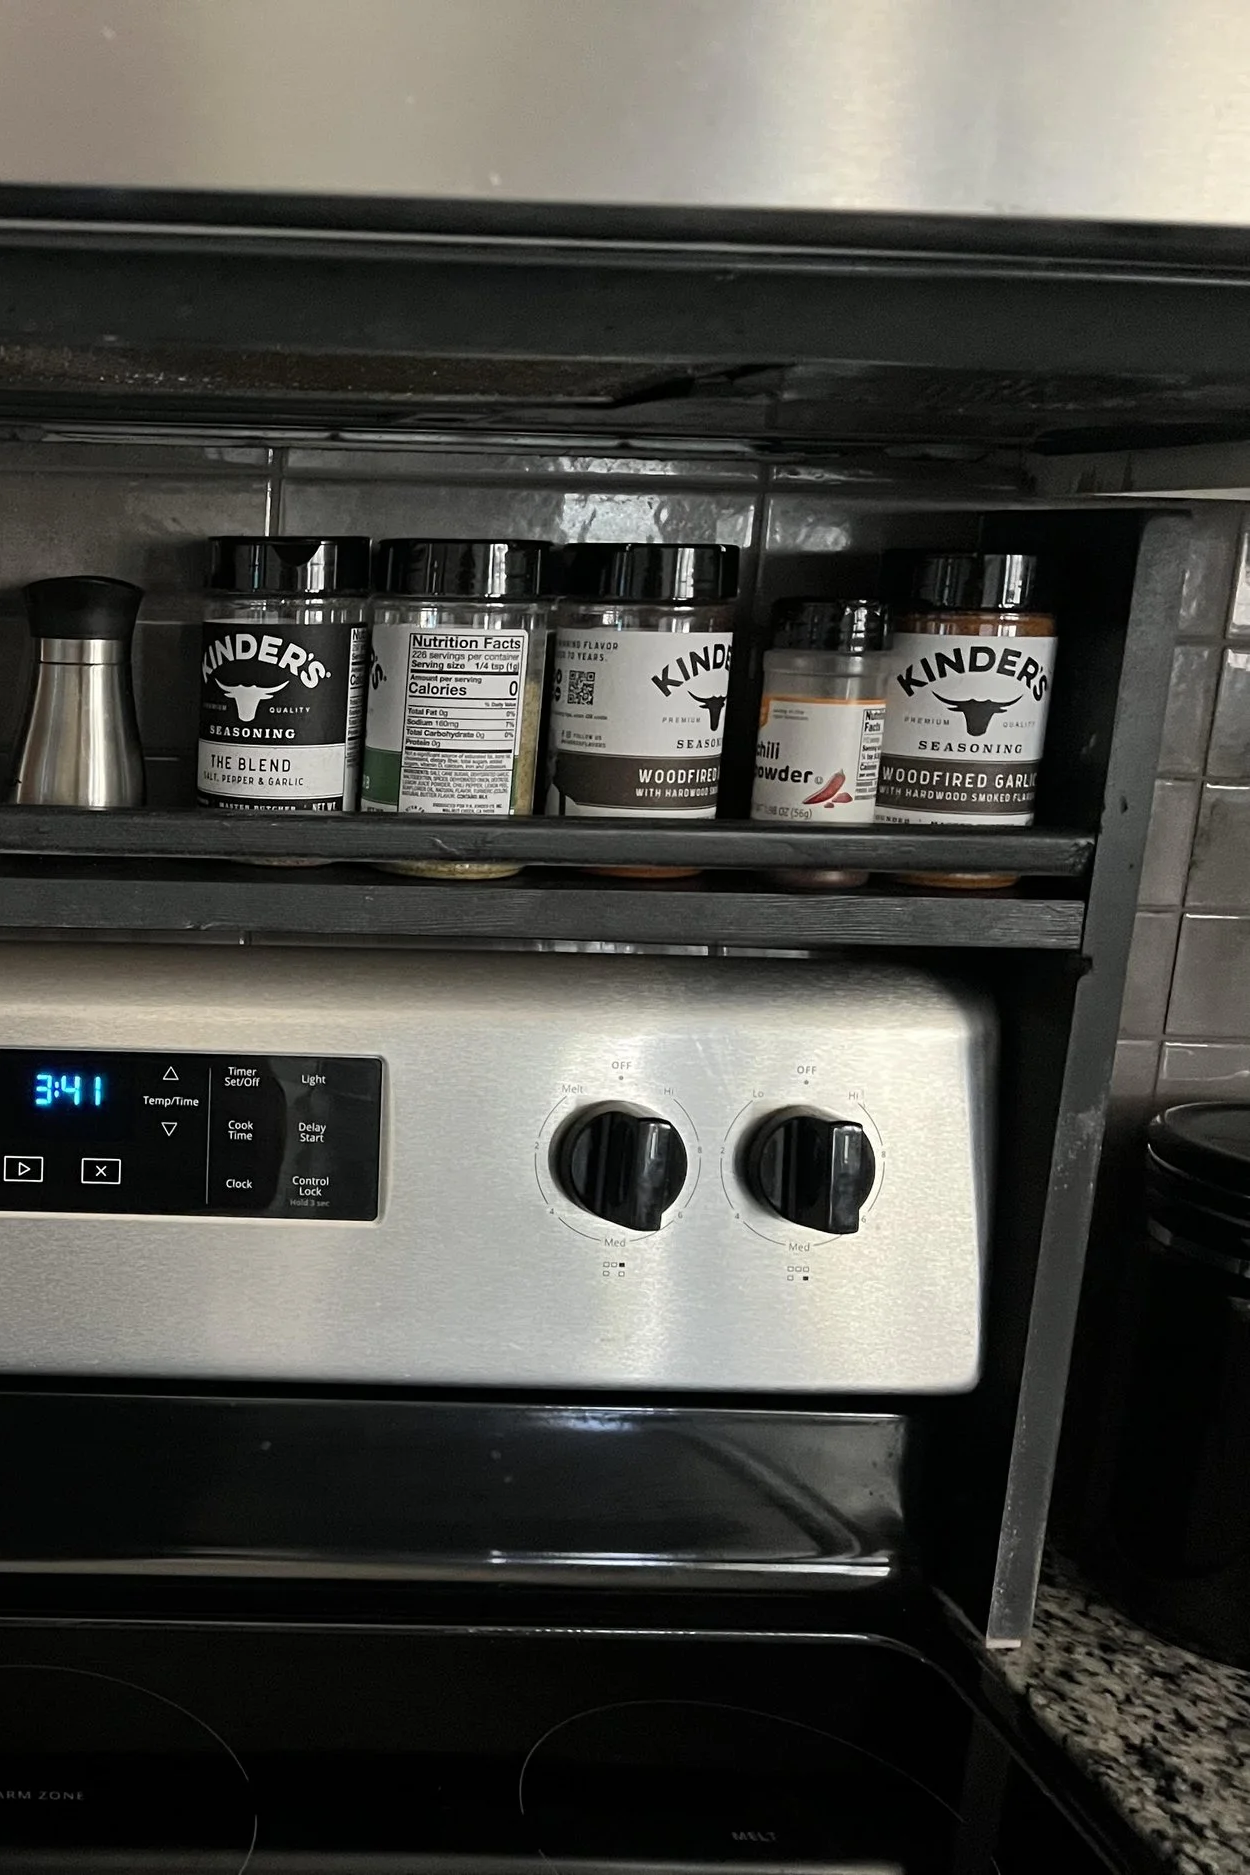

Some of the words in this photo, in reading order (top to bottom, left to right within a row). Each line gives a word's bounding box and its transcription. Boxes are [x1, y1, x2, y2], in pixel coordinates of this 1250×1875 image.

[412, 635, 478, 649] Nutrition
[484, 637, 521, 649] Facts
[583, 641, 619, 650] FLAVOR
[202, 633, 327, 689] KINDER'S
[412, 651, 427, 659] 226
[430, 652, 465, 661] servings
[467, 654, 482, 662] per
[484, 653, 519, 661] container
[411, 660, 444, 670] Serving
[447, 661, 465, 669] size
[475, 662, 489, 670] 1/4
[491, 663, 504, 671] tsp
[410, 674, 438, 682] Amount
[897, 646, 1048, 702] KINDER'S
[409, 682, 467, 696] Calories
[509, 681, 518, 697] 0
[269, 706, 310, 714] QUALITY
[408, 707, 424, 715] Total
[425, 708, 437, 716] Fat
[439, 709, 448, 717] 0g
[407, 718, 433, 727] Sodium
[904, 716, 950, 726] PREMIUM
[209, 725, 296, 739] SEASONING
[424, 729, 474, 739] Carbohydrate
[918, 740, 1023, 754] SEASONING
[211, 754, 232, 770] THE
[238, 757, 291, 772] BLEND
[222, 775, 254, 785] PEPPER
[258, 777, 264, 785] &
[268, 777, 304, 786] GARLIC
[638, 767, 717, 784] WOODFIRED
[882, 766, 988, 788] WOODFIRED
[635, 788, 661, 797] WITH
[665, 787, 709, 797] HARDWOOD
[879, 785, 901, 795] WITH
[905, 788, 967, 802] HARDWOOD
[972, 793, 1010, 802] SMOKED
[790, 808, 812, 819] (56g)
[611, 1060, 632, 1070] OFF
[797, 1065, 817, 1075] OFF
[228, 1066, 257, 1076] Timer
[224, 1077, 260, 1087] Set/Off
[301, 1074, 326, 1086] Light
[36, 1074, 101, 1106] 3:41
[561, 1084, 584, 1094] Melt
[663, 1086, 674, 1096] Hi
[752, 1089, 764, 1098] Lo
[848, 1090, 859, 1100] Hi
[143, 1095, 200, 1108] Temp/Time
[228, 1120, 254, 1130] Cook
[299, 1122, 326, 1134] Delay
[228, 1130, 253, 1141] Time
[300, 1133, 325, 1143] Start
[226, 1179, 253, 1189] Clock
[292, 1176, 329, 1186] Control
[299, 1187, 322, 1196] Lock
[604, 1238, 626, 1247] Med
[788, 1242, 810, 1252] Med
[38, 1791, 85, 1800] ZONE
